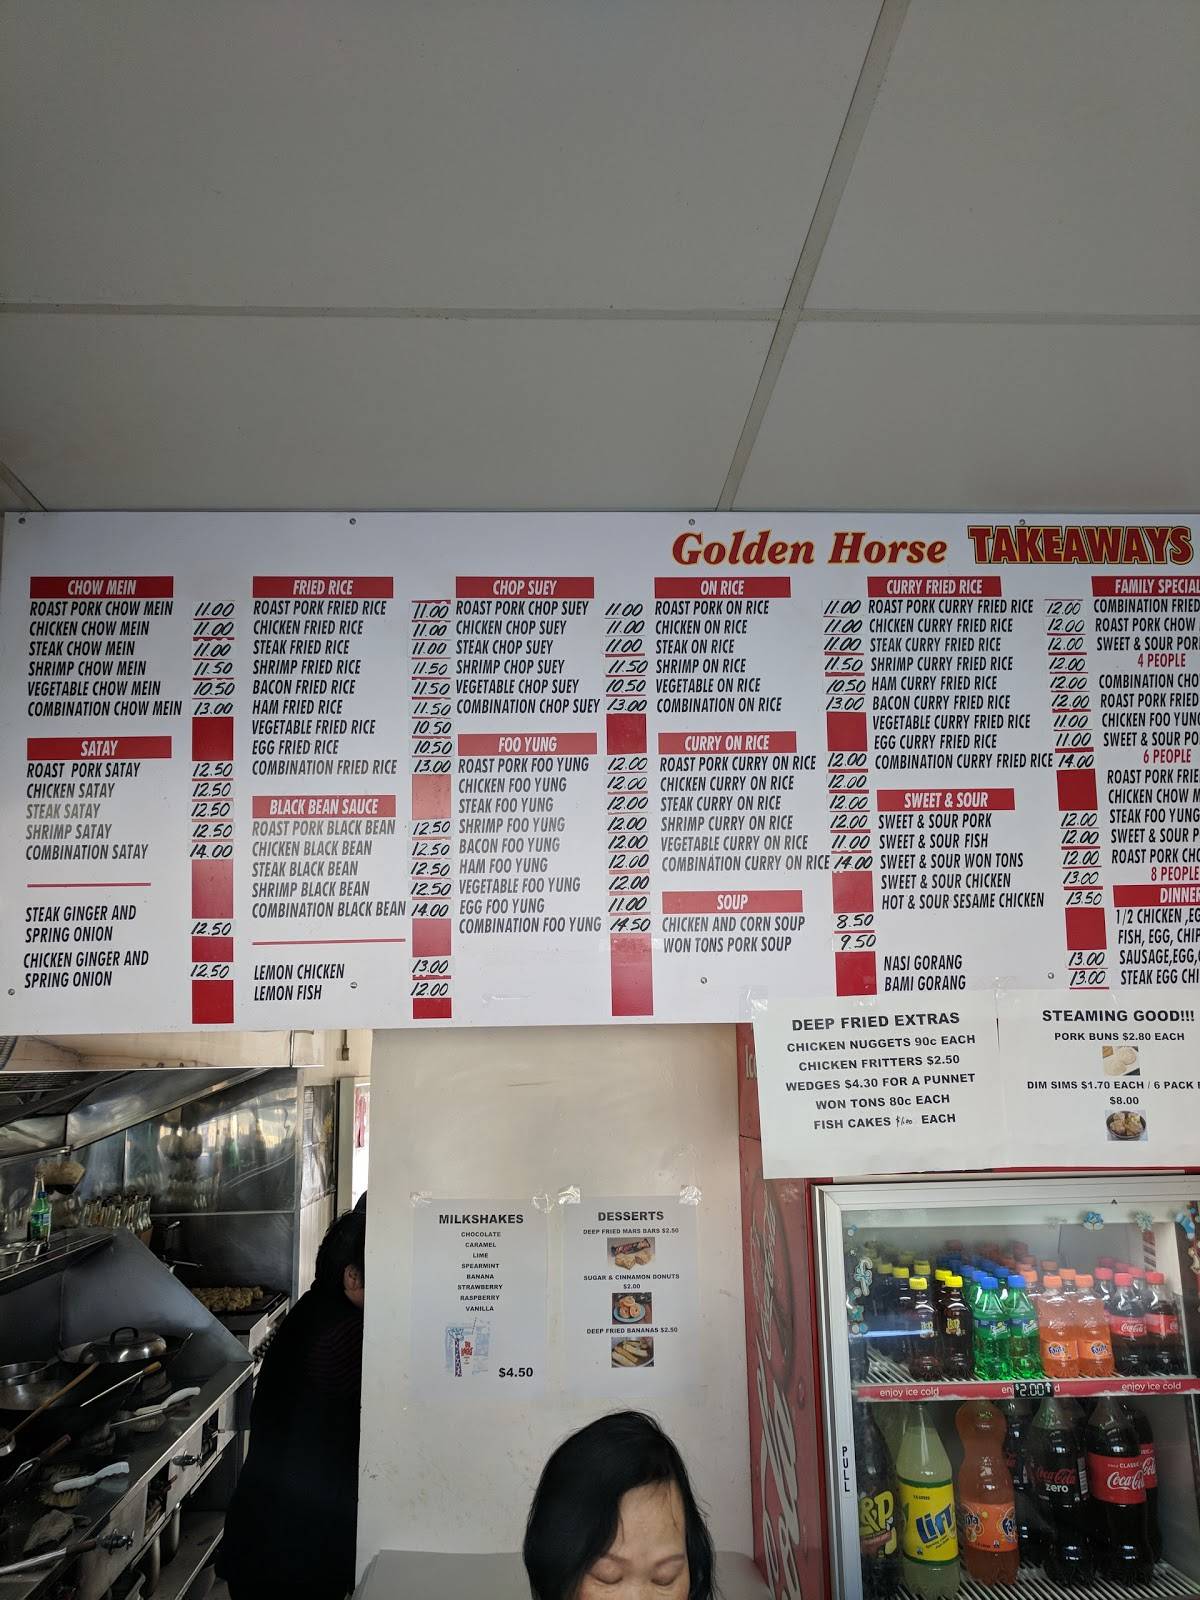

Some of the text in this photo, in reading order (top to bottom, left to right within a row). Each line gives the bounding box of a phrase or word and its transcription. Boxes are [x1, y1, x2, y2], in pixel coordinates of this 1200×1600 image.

[672, 525, 1194, 567] Golden Horse TAKEAWAYS
[68, 580, 136, 595] CHOW MEIN
[293, 580, 354, 595] FRIED RICE
[493, 580, 557, 595] CHOP SUEY
[701, 580, 744, 595] ON RICE
[887, 579, 982, 594] CURRY FRIED RICE
[1115, 579, 1155, 594] FAMILY
[30, 600, 174, 616] ROAST PORK CHOW MEIN
[195, 602, 235, 617] 11.00
[1137, 653, 1186, 668] 4 PEOPLE
[456, 679, 580, 694] VEGETABLE CHOP SUEY
[606, 679, 646, 693] 10.50
[80, 740, 118, 756] SATAY
[498, 736, 557, 752] FOO YUNG
[685, 735, 770, 751] CURRY ON RICE
[1153, 748, 1191, 764] PEOPLE
[270, 798, 379, 815] BLACK BEAN SAUCE
[904, 792, 988, 808] SWEET & SOUR
[26, 844, 149, 860] COMBINATION SATAY
[189, 843, 233, 859] 14.00
[717, 894, 748, 910] SOUP
[882, 892, 1044, 910] HOT & SOUR SESAME CHICKEN
[1066, 891, 1102, 906] 13.50
[25, 905, 136, 922] STEAK GINGER AND
[25, 926, 113, 943] SPRING ONION
[191, 921, 232, 936] 12.50
[664, 936, 792, 953] WON TONS PORK SOUP
[841, 934, 877, 951] 9.50
[412, 959, 449, 974] 13.00
[884, 954, 962, 971] NASI GORANG
[1068, 952, 1105, 966] 13.00
[254, 963, 345, 980] LEMON CHICKEN
[254, 984, 322, 1001] LEMON FISH
[410, 982, 449, 997] 12.00
[792, 1012, 960, 1031] DEEP FRIED EXTRAS
[1042, 1010, 1195, 1022] STEAMING GOOD!!!
[787, 1034, 975, 1052] CHICKEN NUGGETS 90c EACH
[1054, 1032, 1185, 1041] PORK BUNS $2.80 EACH
[799, 1054, 960, 1071] CHICKEN FRITTERS $2.50
[785, 1073, 975, 1092] WEDGES $4.30 FOR A PUNNET
[1027, 1081, 1047, 1089] DIM
[1051, 1081, 1078, 1089] SIMS
[1081, 1081, 1110, 1090] $1.70
[1114, 1081, 1144, 1089] EACH
[1153, 1081, 1161, 1090] 6
[1164, 1081, 1194, 1089] PACK
[815, 1094, 950, 1110] WON TONS 80c EACH
[1109, 1096, 1139, 1105] $8.00
[814, 1117, 891, 1130] FISH CAKES
[921, 1113, 956, 1124] EACH
[439, 1214, 524, 1224] MILKSHAKES
[598, 1211, 664, 1221] DESSERTS
[499, 1367, 533, 1378] $4.50
[880, 1386, 940, 1397] enjoy ice cold
[1015, 1383, 1045, 1397] $2.00
[1121, 1381, 1181, 1393] enjoy ice cold
[842, 1446, 850, 1493] PULL
[1045, 1483, 1069, 1493] zero
